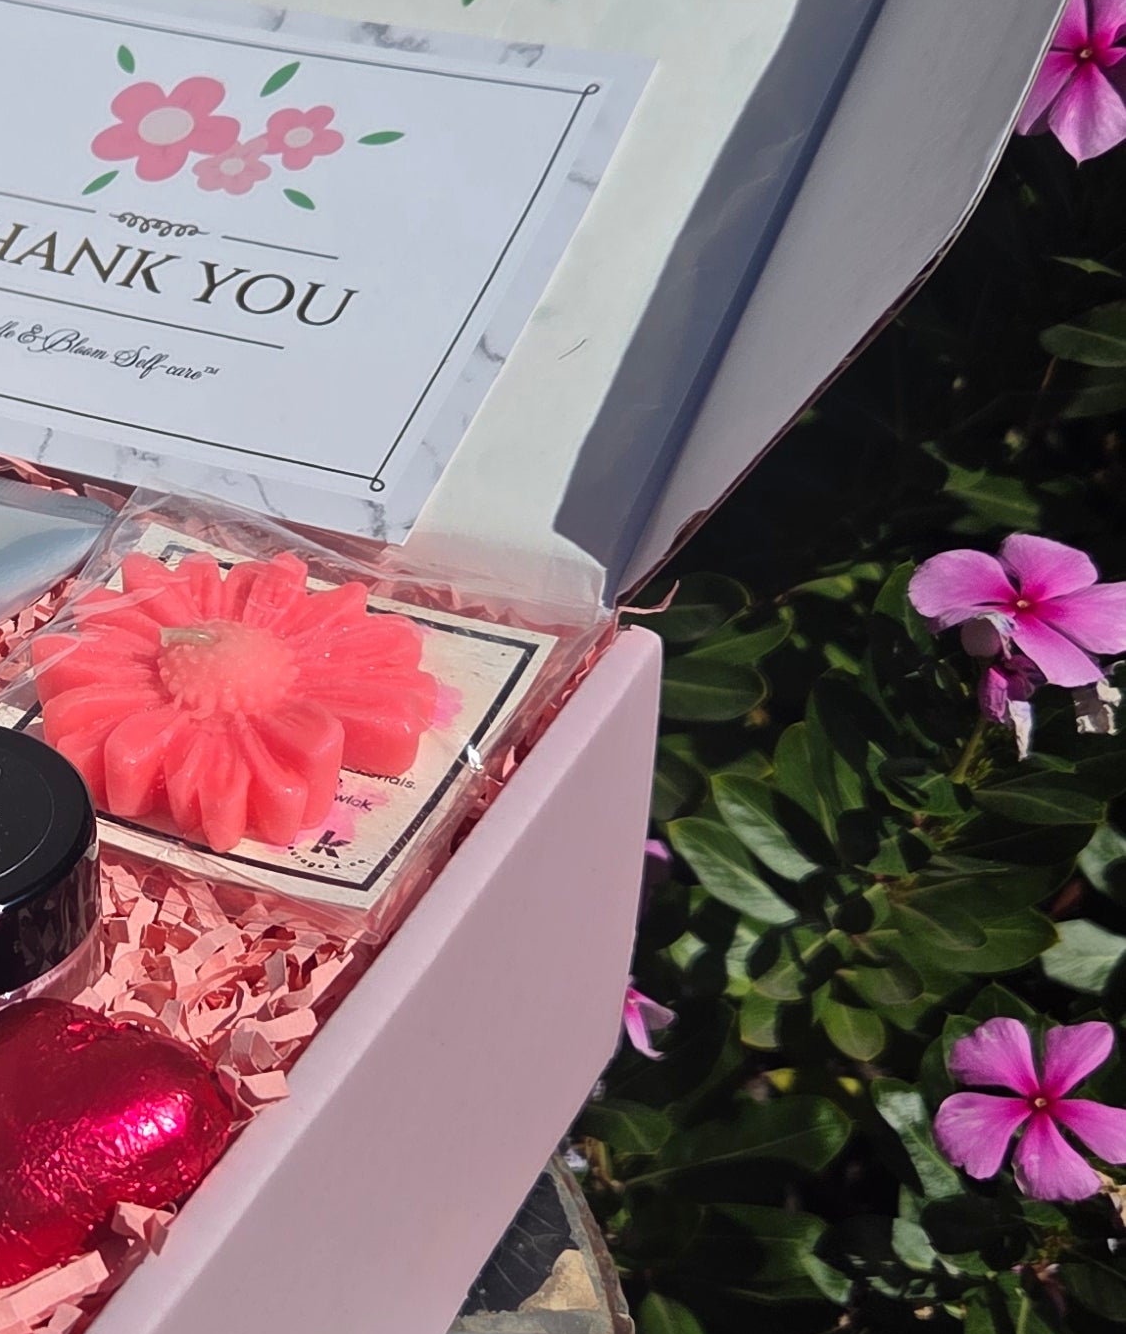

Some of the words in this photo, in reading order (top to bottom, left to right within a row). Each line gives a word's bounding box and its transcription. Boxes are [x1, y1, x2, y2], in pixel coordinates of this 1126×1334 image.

[193, 260, 359, 326] YOU
[17, 324, 47, 344] &
[27, 328, 109, 360] Bloom
